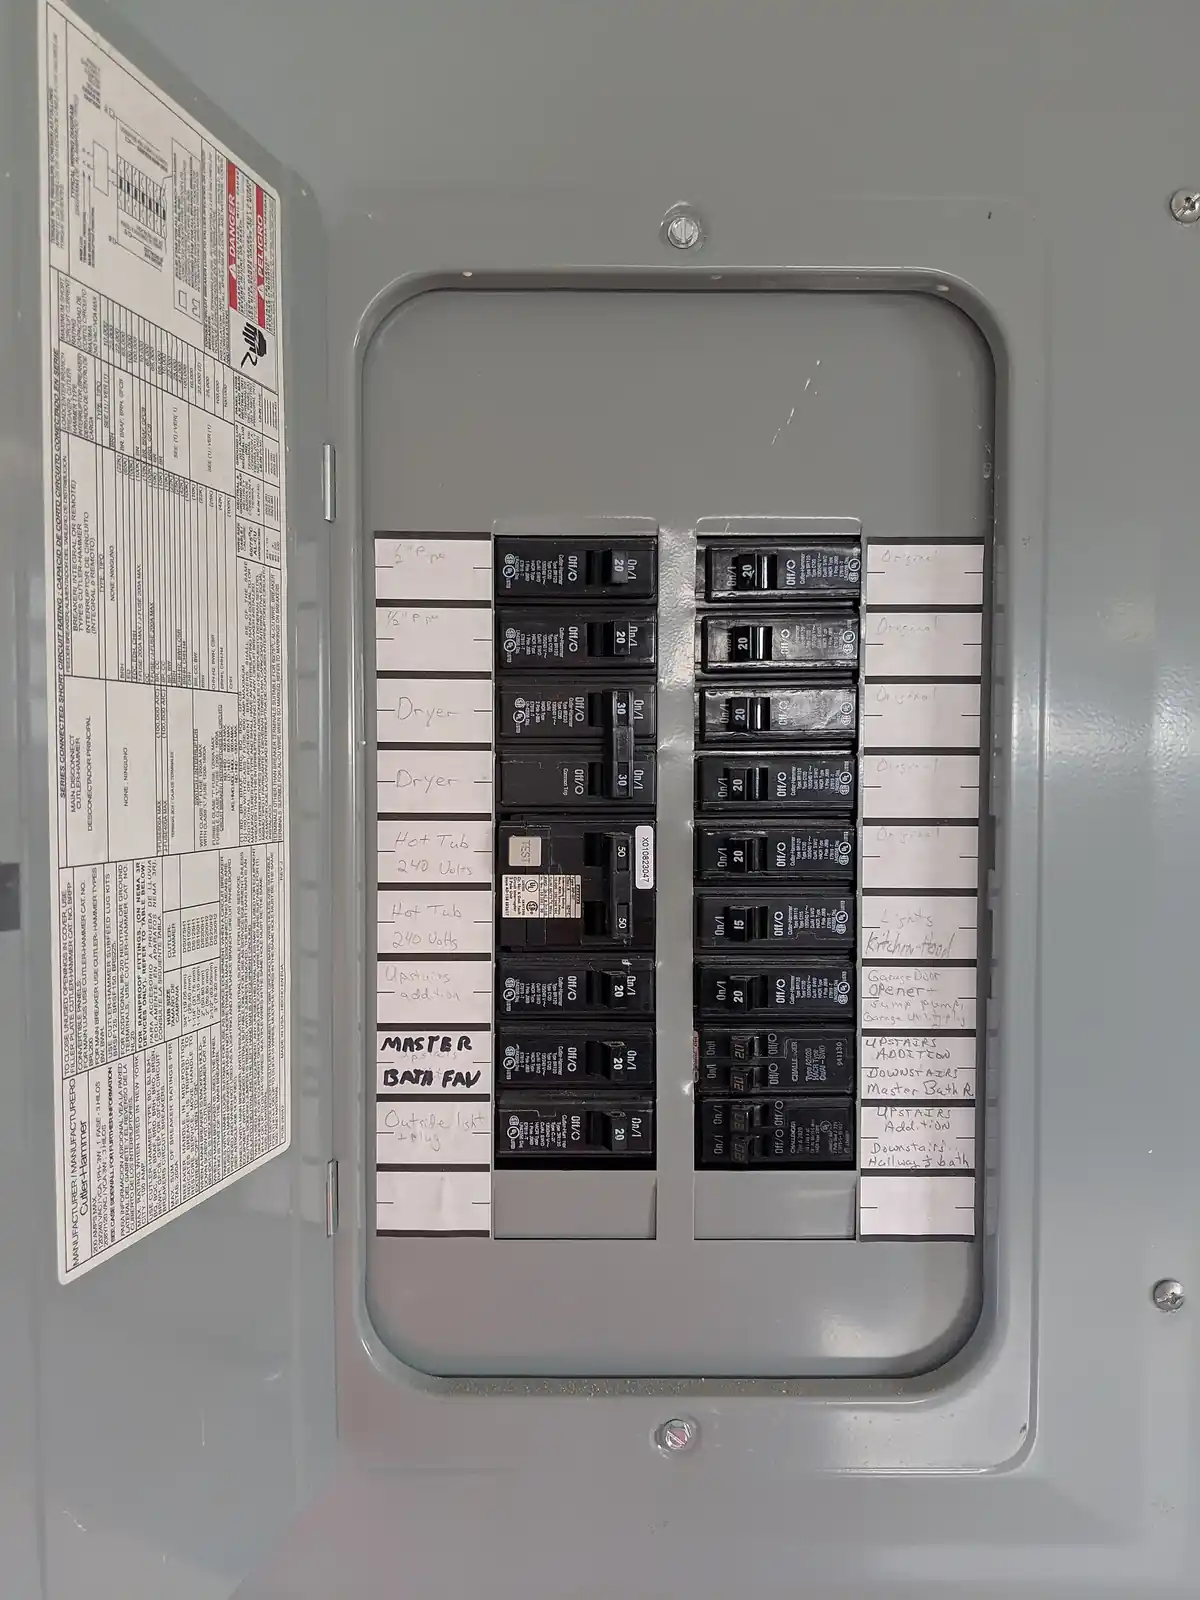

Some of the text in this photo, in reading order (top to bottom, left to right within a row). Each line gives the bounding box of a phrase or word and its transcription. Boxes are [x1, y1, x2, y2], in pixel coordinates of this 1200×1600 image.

[416, 545, 445, 564] Ppe
[614, 559, 624, 572] 20
[742, 564, 752, 577] 20
[412, 613, 439, 625] Ppe
[616, 631, 625, 644] 20
[738, 637, 748, 650] 20
[397, 696, 459, 727] Dryer
[617, 702, 626, 715] 30
[735, 708, 745, 720] 20
[396, 769, 458, 794] Dryer
[618, 774, 627, 786] 30
[733, 779, 742, 792] 20
[395, 831, 469, 849] Hot Tub
[520, 840, 530, 863] TEST
[618, 846, 626, 857] 50
[734, 850, 743, 862] 20
[397, 860, 473, 876] 240 Volts
[392, 902, 462, 918] Hot Tub
[618, 917, 626, 928] 50
[880, 906, 933, 929] Lights
[734, 920, 744, 929] 15
[62, 942, 67, 950] IN
[392, 931, 458, 950] 240 Volts
[386, 965, 451, 984] Upstairs
[868, 968, 941, 984] Garage Door
[614, 985, 623, 997] 20
[734, 990, 744, 1003] 20
[380, 1035, 472, 1053] MASTER
[866, 1037, 937, 1048] UPSTAIRS
[735, 1044, 744, 1059] 20
[64, 1064, 70, 1075] TO
[614, 1058, 623, 1070] 20
[383, 1068, 434, 1087] BATH
[866, 1068, 958, 1078] DOWNSTAIRS
[734, 1076, 744, 1091] 20
[867, 1082, 919, 1096] Master
[922, 1080, 958, 1096] Bath
[385, 1109, 485, 1131] Outside lght
[615, 1128, 624, 1140] 20
[870, 1140, 947, 1154] Downstairs
[868, 1155, 920, 1168] Hallway
[937, 1152, 970, 1168] bath
[69, 1079, 79, 1266] MANUFACTURER MANUFACTURERO
[79, 1120, 88, 1216] Cutler-Hammer
